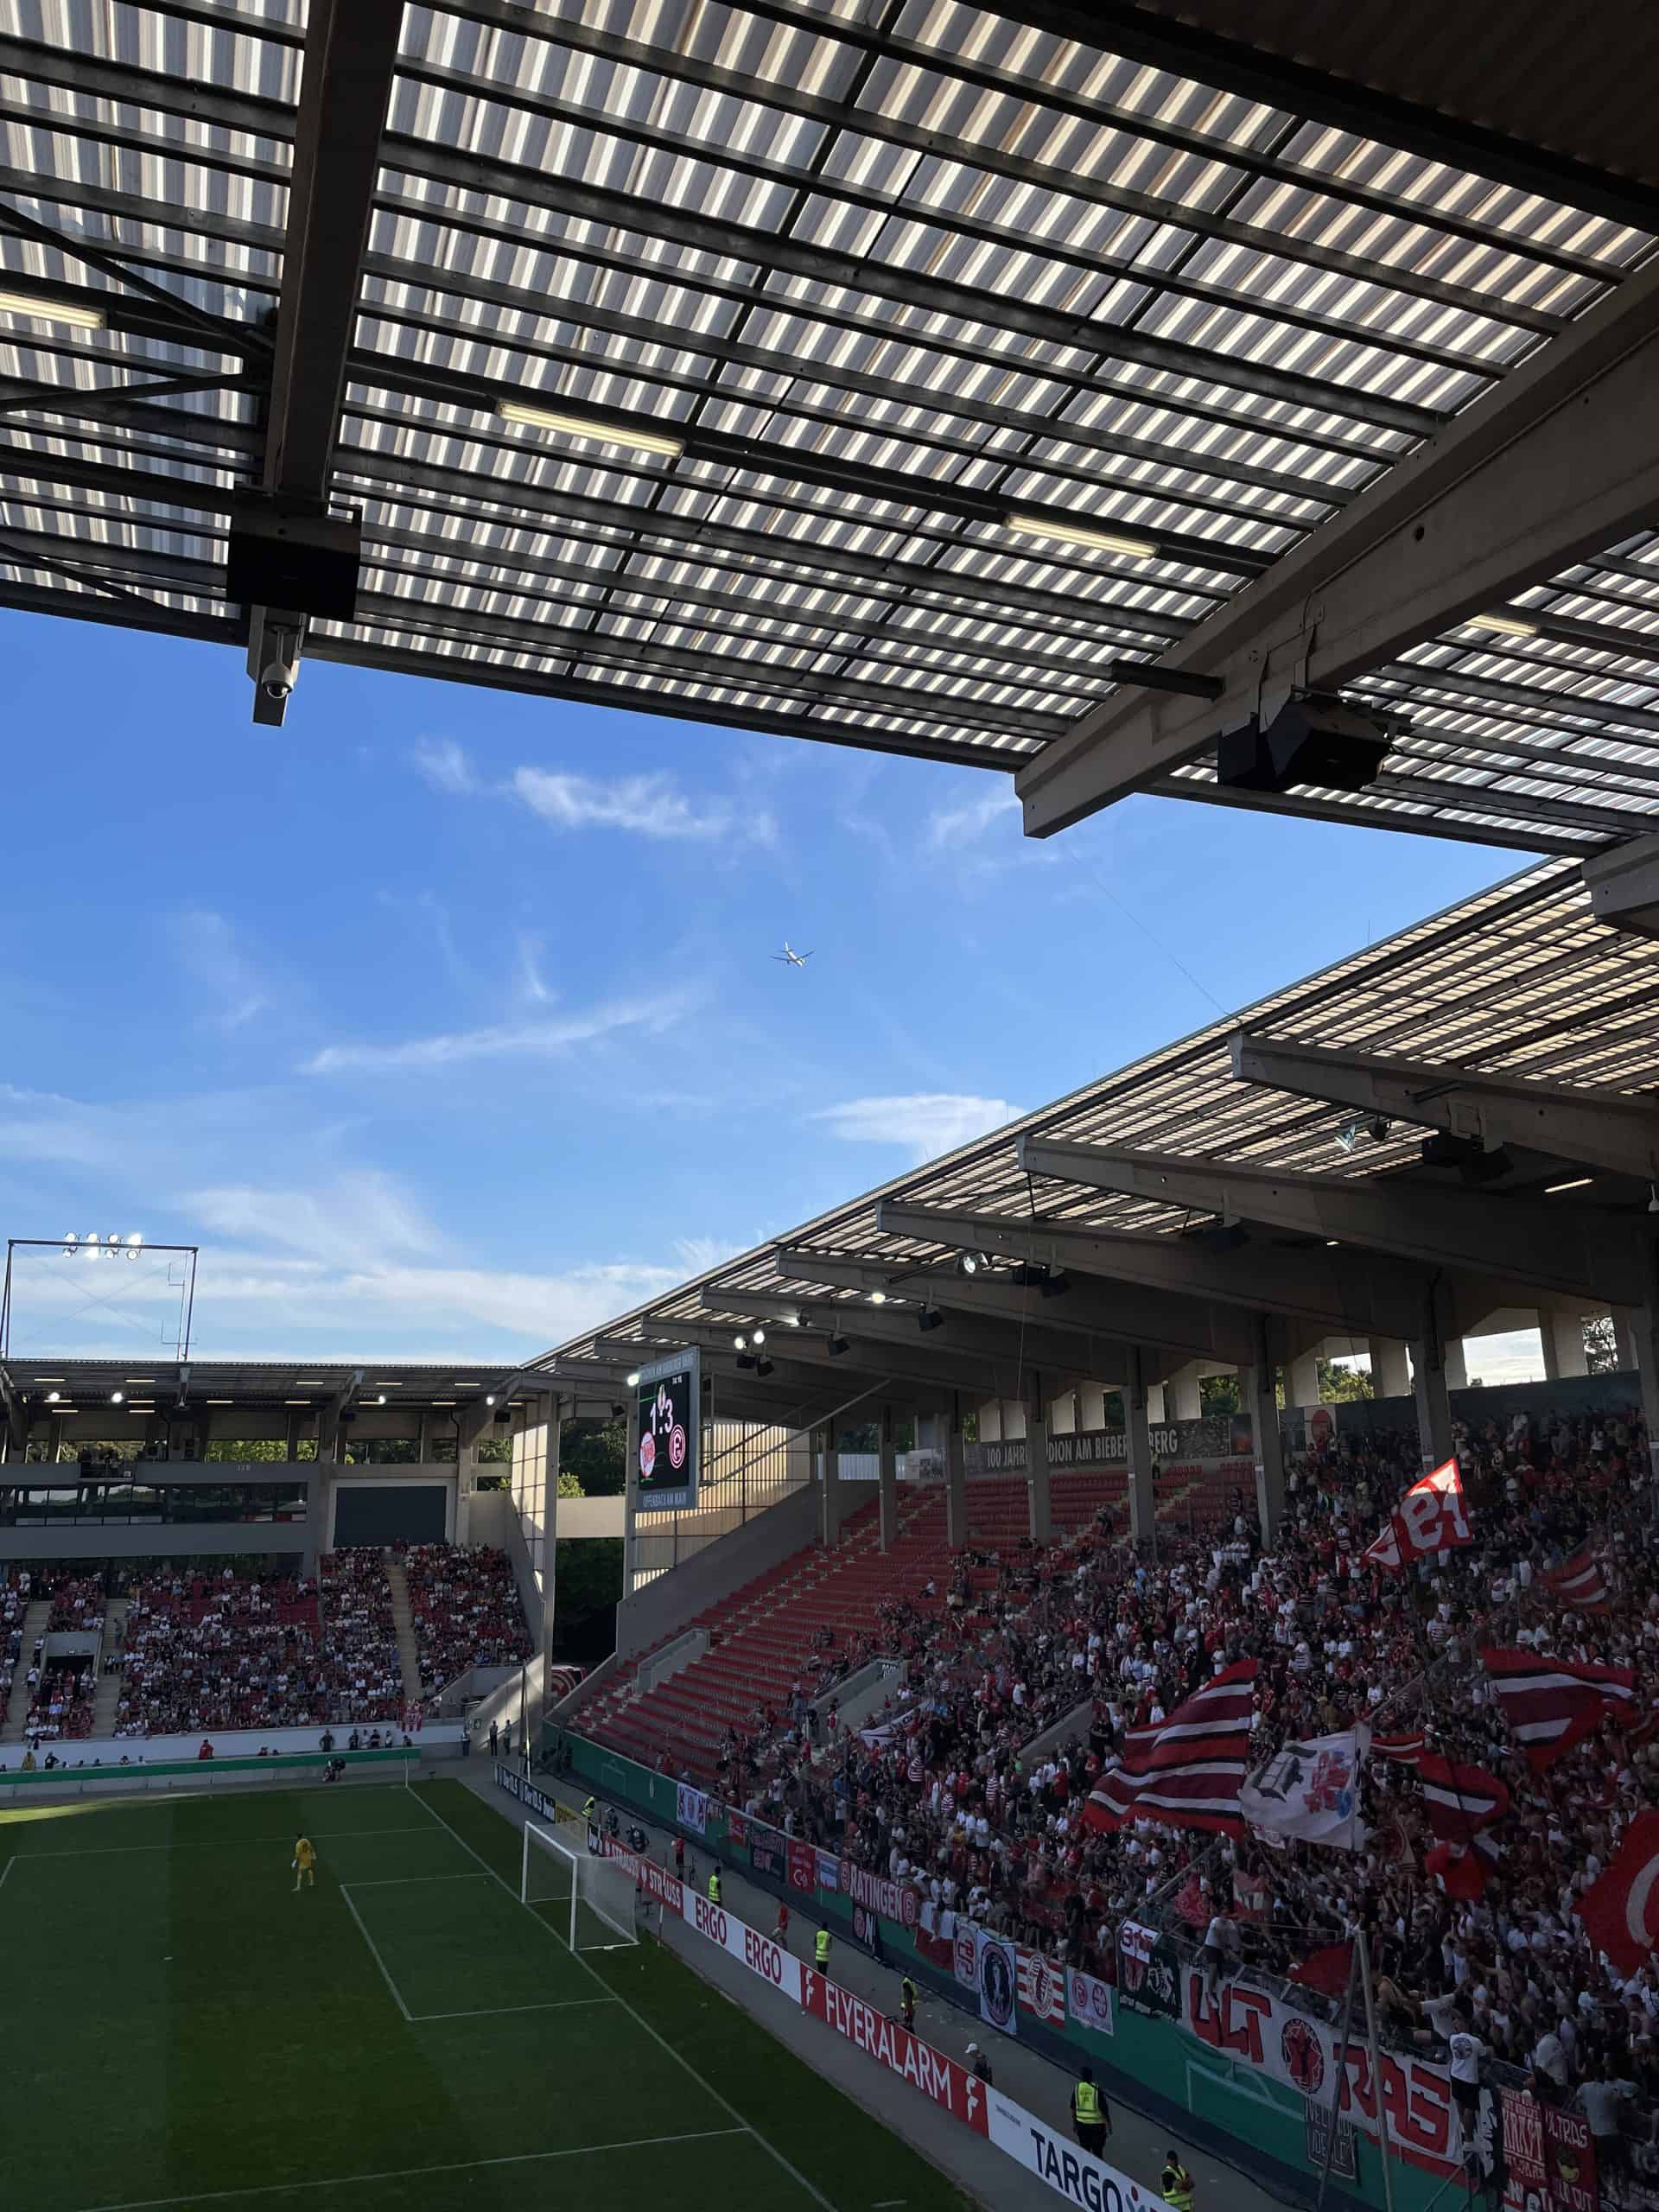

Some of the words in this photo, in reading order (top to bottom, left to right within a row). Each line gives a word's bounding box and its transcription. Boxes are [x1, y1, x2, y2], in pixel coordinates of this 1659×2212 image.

[987, 1446, 1001, 1468] 100
[1002, 1443, 1029, 1466] JAHR
[1046, 1441, 1072, 1462] DION
[1075, 1438, 1092, 1460] AM
[1095, 1433, 1127, 1459] BIEBER
[696, 1897, 727, 1946] ERGO
[849, 1862, 902, 1923] RATINGEN
[745, 1928, 782, 1986] ERGO
[825, 1986, 951, 2109] FLYERALARM
